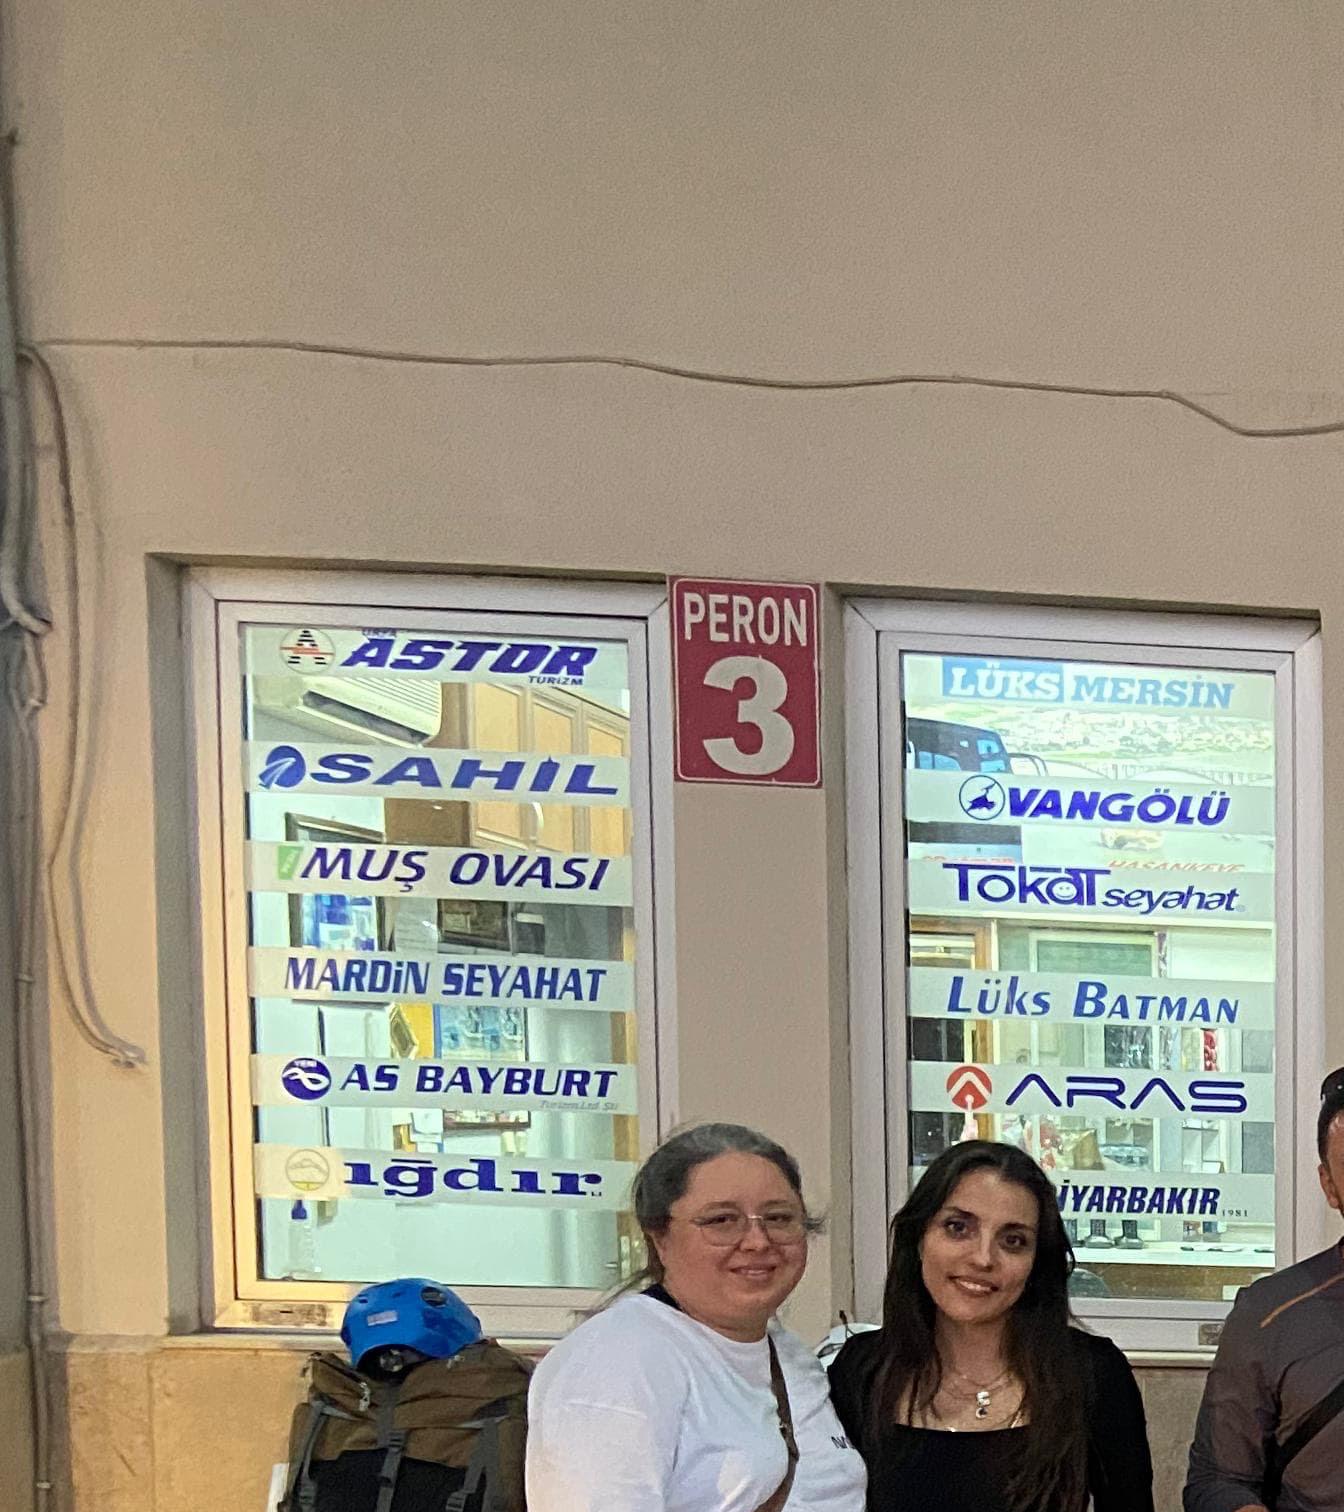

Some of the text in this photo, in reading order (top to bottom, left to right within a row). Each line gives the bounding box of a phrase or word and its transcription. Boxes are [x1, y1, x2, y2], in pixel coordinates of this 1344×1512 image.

[684, 593, 808, 646] PERON
[340, 638, 598, 676] ASTOR
[951, 663, 1236, 709] LÜKS MERSİN
[702, 654, 795, 777] 3
[310, 753, 618, 795] SAHİL
[1008, 787, 1231, 826] VANGÖLÜ
[300, 848, 610, 892] MUŞ OVASI
[1102, 886, 1239, 915] seyahat
[441, 963, 607, 1002] SEYAHAT
[947, 975, 1051, 1016] Lüks
[340, 1063, 617, 1098] AS BAYBURT
[1005, 1074, 1248, 1114] ARAS
[1056, 1179, 1248, 1217] İYARBAKIR 1981
